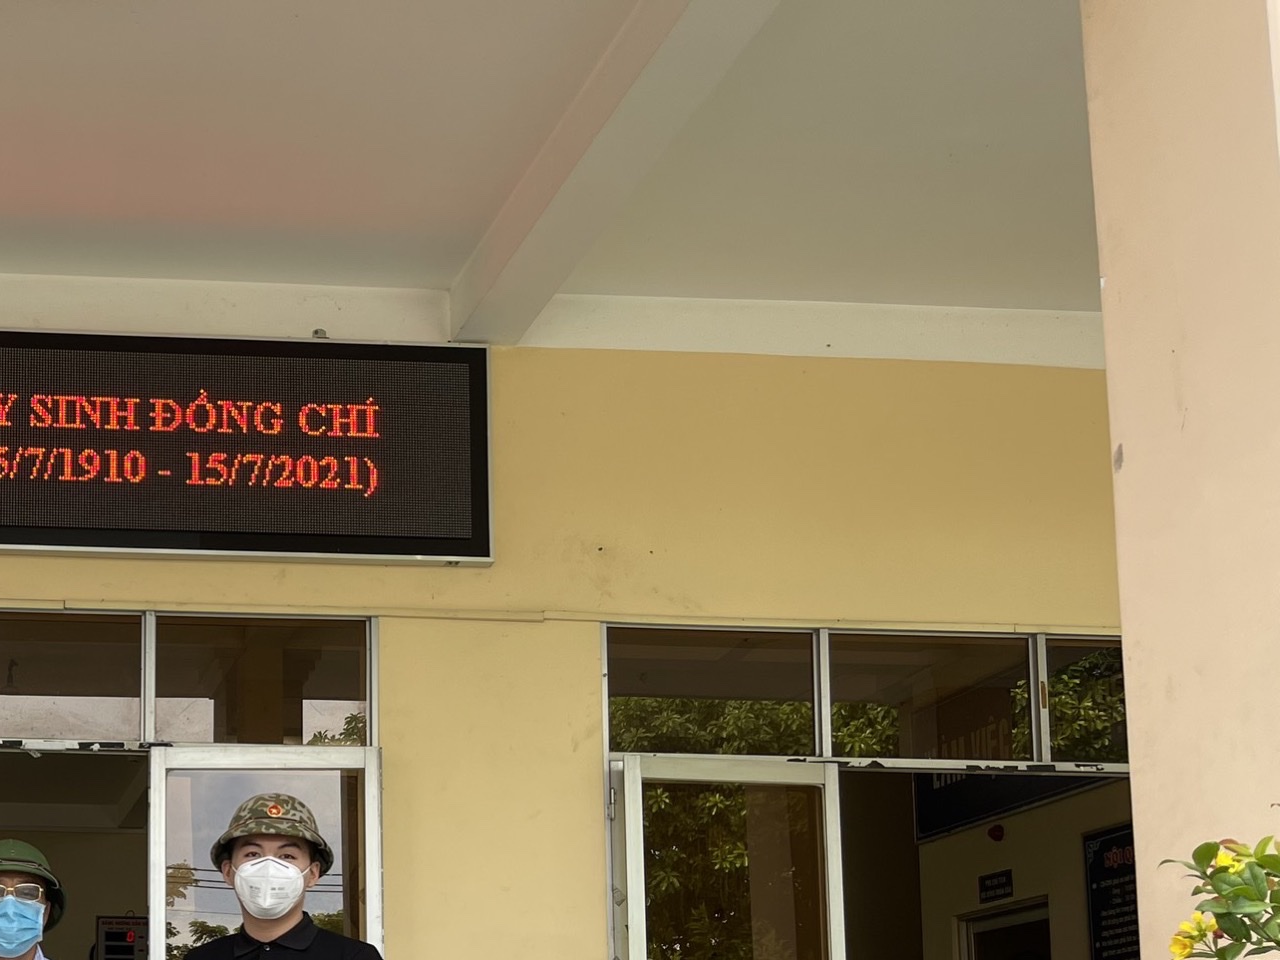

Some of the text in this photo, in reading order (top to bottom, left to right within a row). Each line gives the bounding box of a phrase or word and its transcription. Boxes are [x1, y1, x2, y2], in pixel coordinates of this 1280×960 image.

[29, 393, 141, 431] SINH
[148, 388, 285, 435] ĐỒNG
[298, 396, 381, 438] CHÍ
[185, 451, 379, 498] 15/7/2021)
